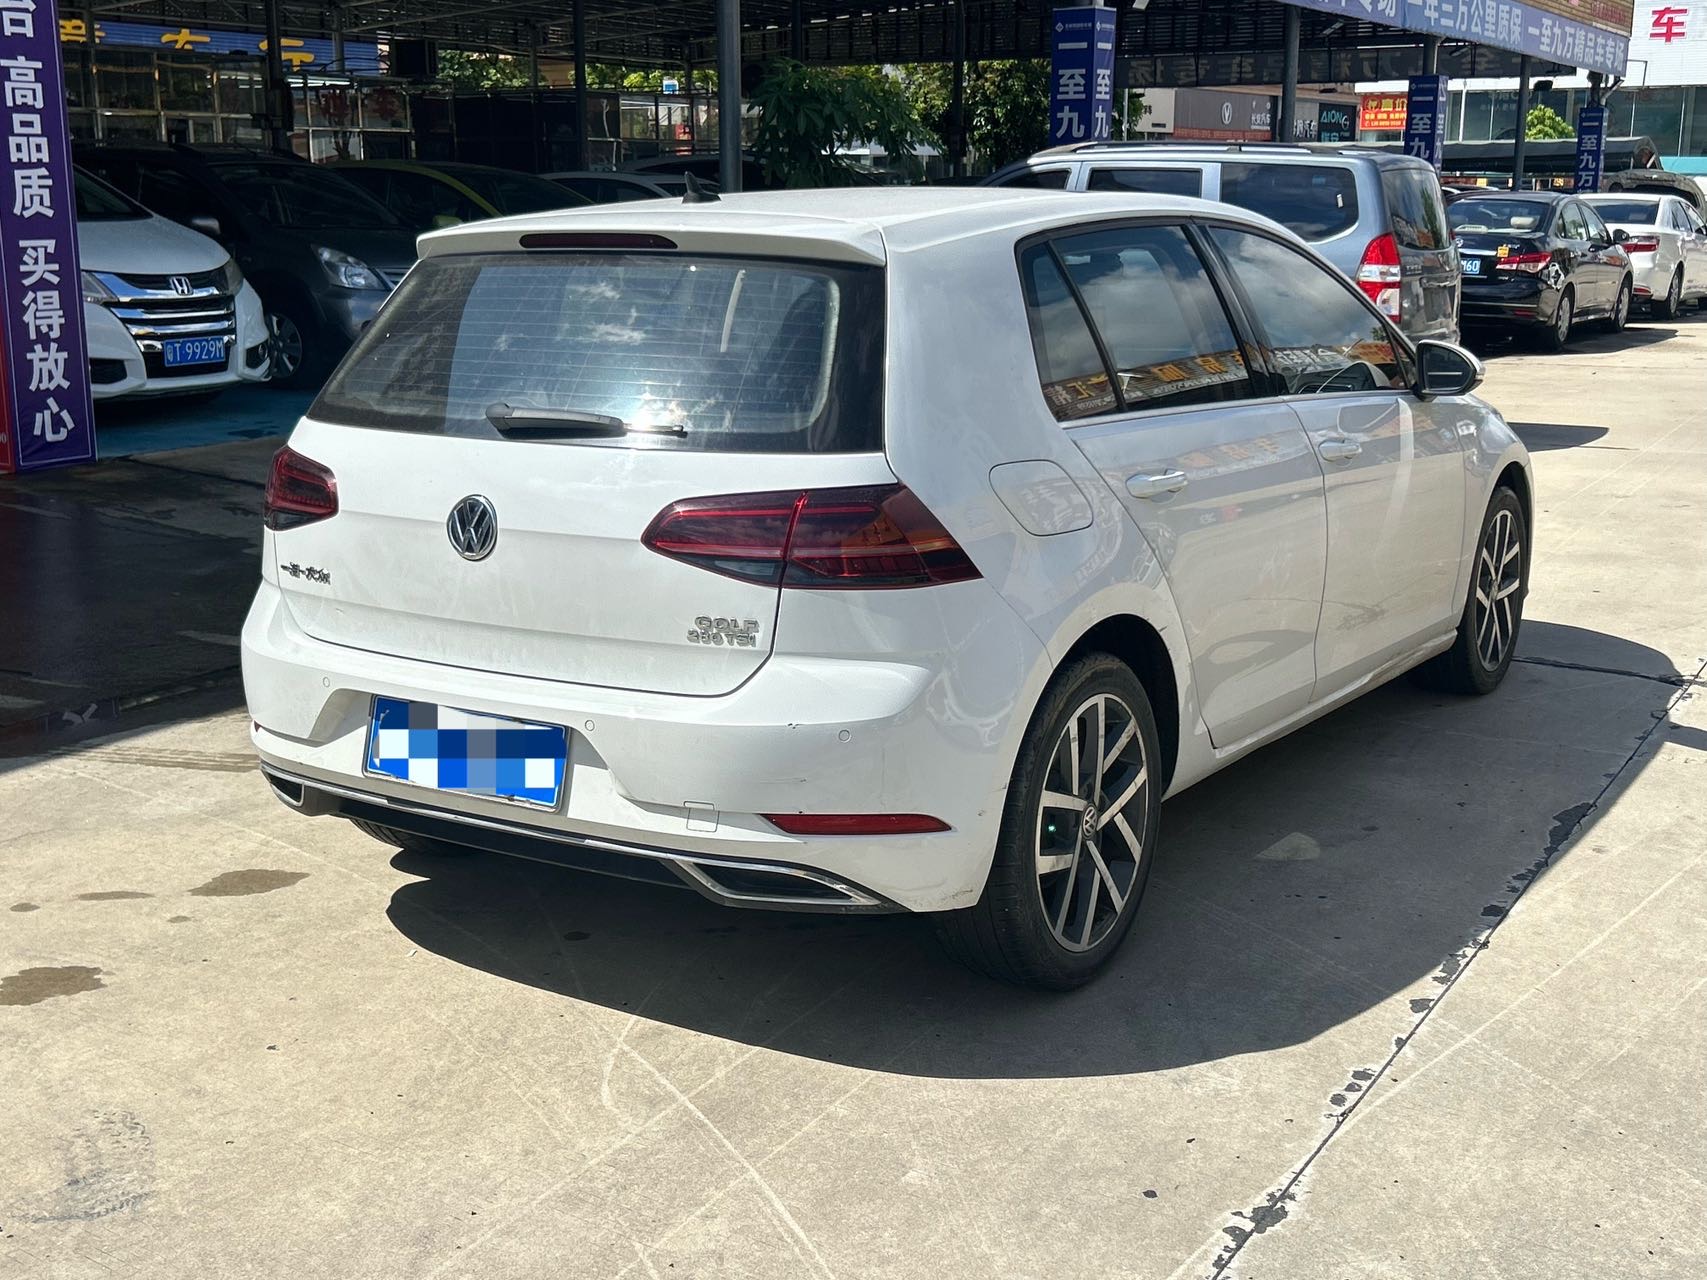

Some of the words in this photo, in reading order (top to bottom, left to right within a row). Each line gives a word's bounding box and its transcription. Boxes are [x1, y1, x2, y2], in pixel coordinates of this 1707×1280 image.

[1527, 18, 1624, 71] 一至九万精品车专场
[1650, 7, 1687, 43] 车
[0, 55, 54, 219] 高品质
[1056, 42, 1088, 138] 一至九
[1094, 42, 1112, 138] 一至九
[1577, 122, 1599, 193] 一至九万
[18, 239, 75, 442] 买得放心
